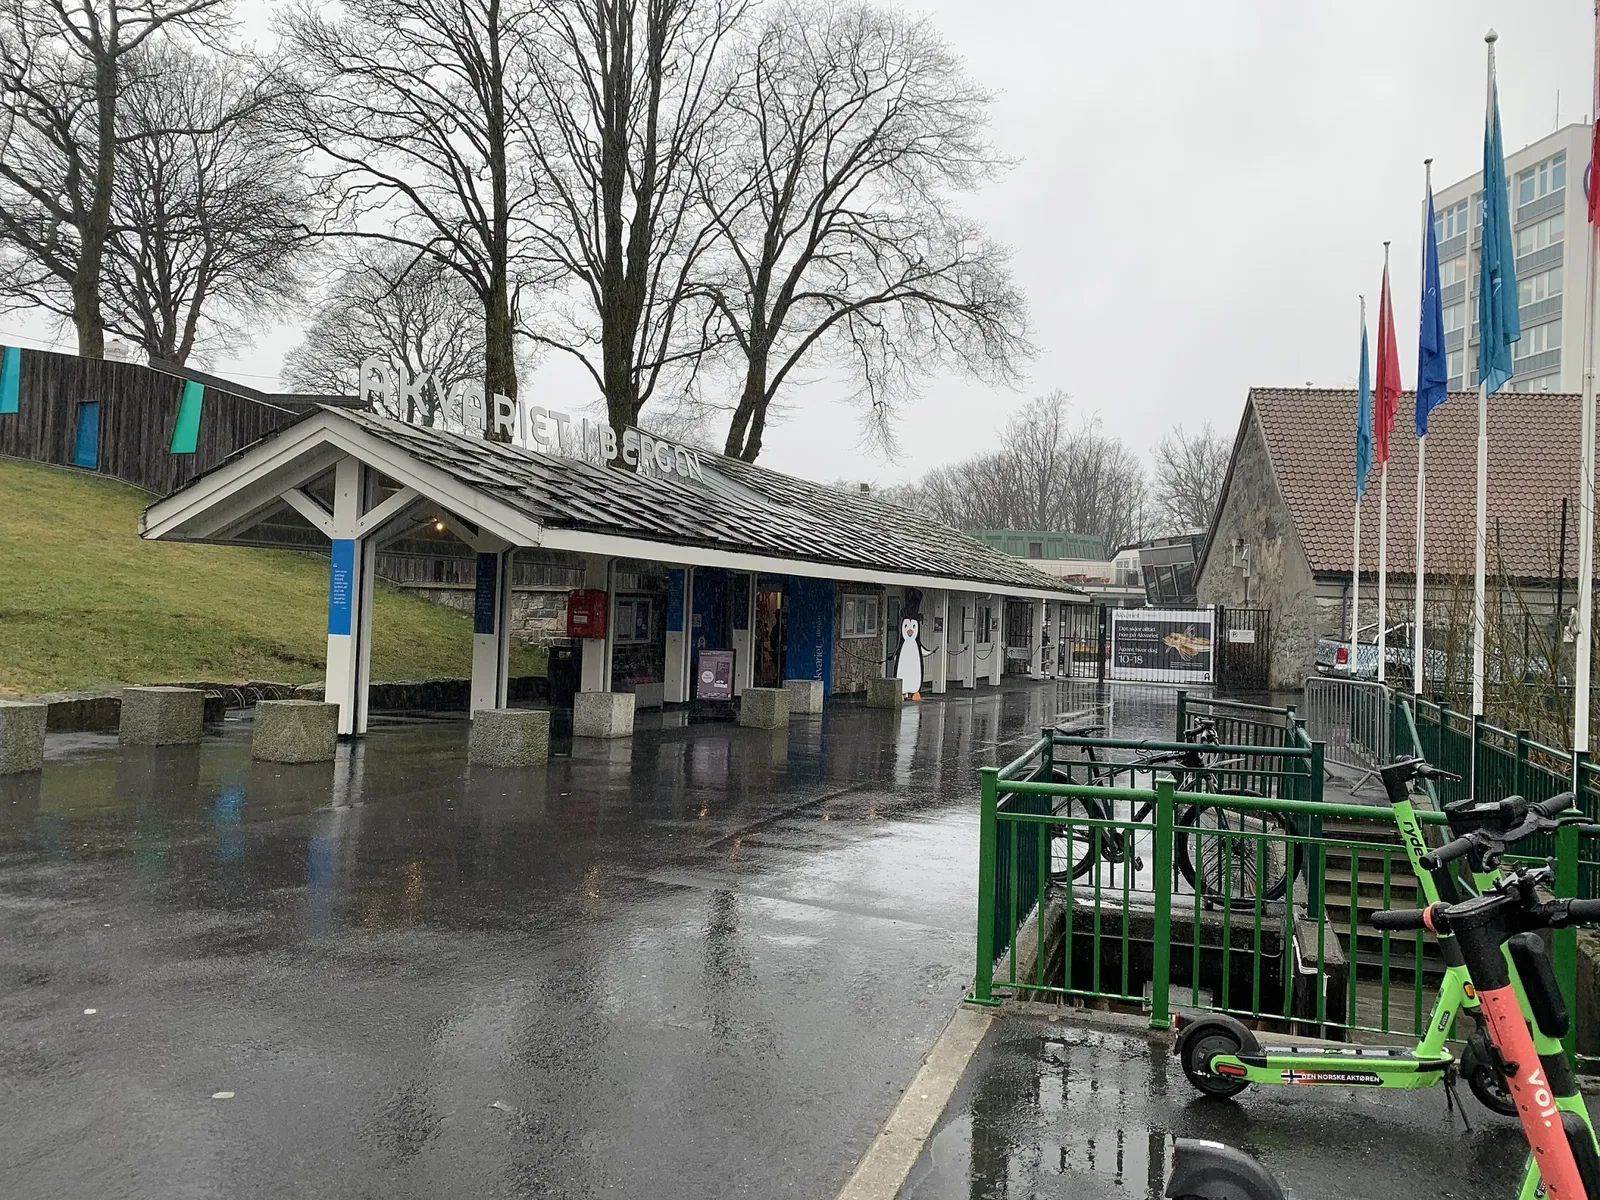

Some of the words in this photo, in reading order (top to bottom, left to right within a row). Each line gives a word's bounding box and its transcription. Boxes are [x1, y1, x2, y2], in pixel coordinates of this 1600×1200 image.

[359, 357, 571, 448] AKVARIET
[582, 417, 590, 455] I
[597, 423, 705, 484] BERGEN
[813, 643, 824, 681] kvariet
[1118, 654, 1143, 665] 10-18
[1402, 821, 1424, 857] ryde
[1346, 1074, 1380, 1083] AKTØREN
